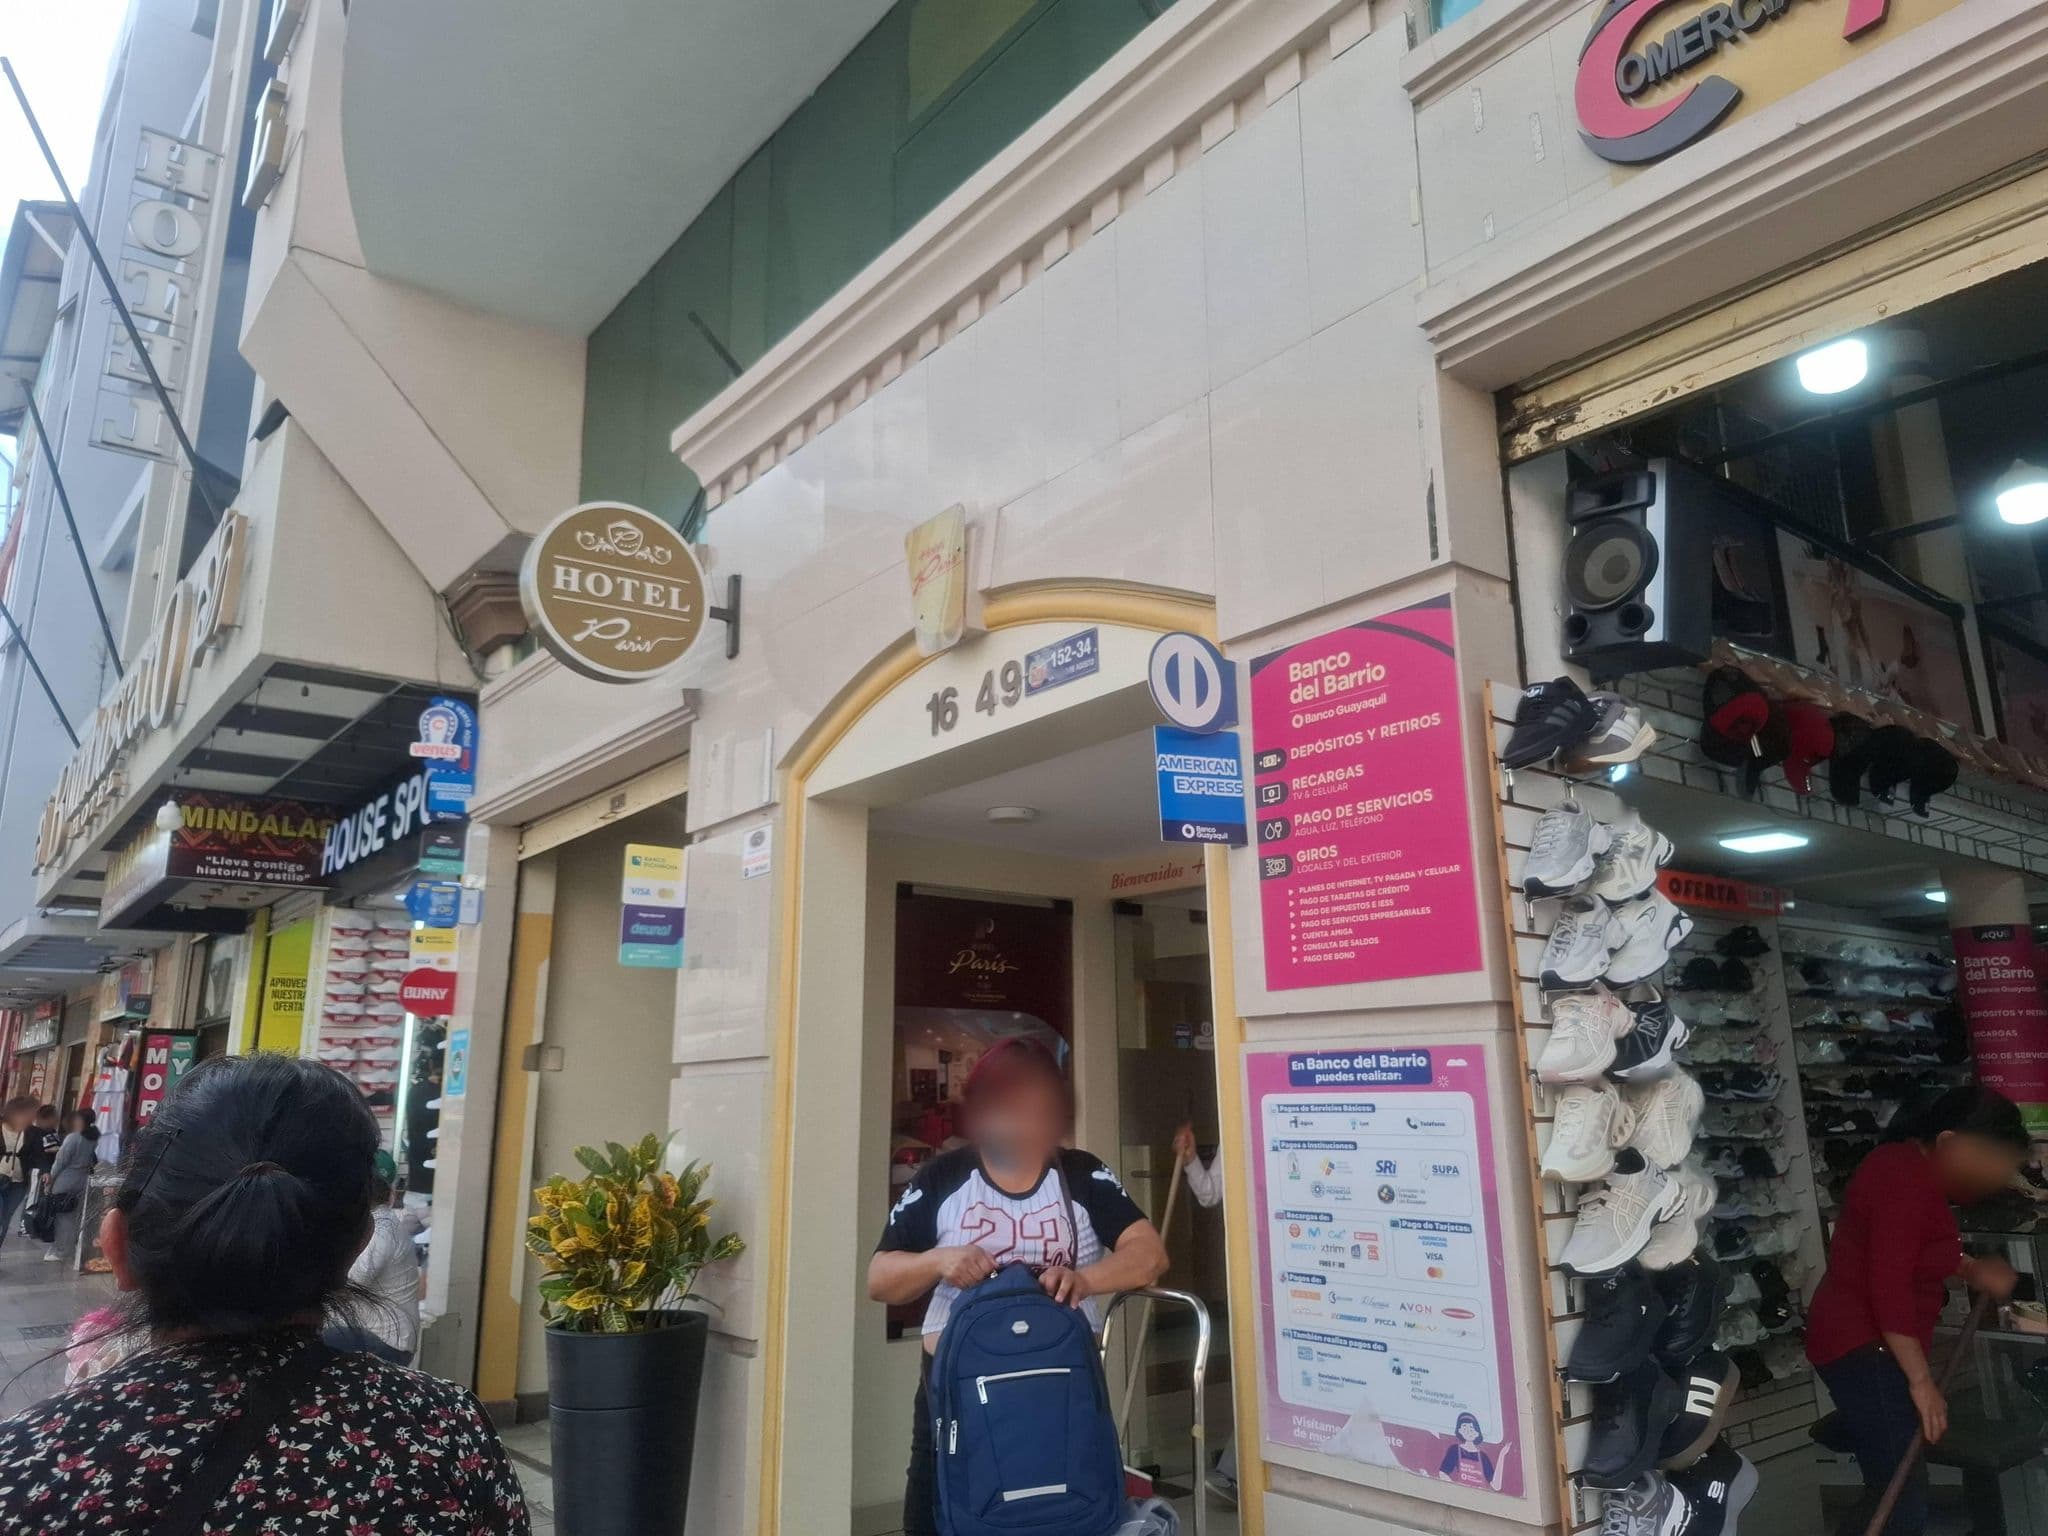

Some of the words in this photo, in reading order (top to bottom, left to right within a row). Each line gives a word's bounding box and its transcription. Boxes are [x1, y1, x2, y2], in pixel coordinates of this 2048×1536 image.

[553, 564, 691, 613] HOTEL
[1051, 637, 1092, 668] 152-34
[1289, 651, 1350, 682] Banco
[1290, 682, 1319, 704] del
[1323, 662, 1386, 695] Barrio
[926, 686, 959, 737] 16
[976, 660, 1023, 717] 49
[1304, 707, 1334, 725] Banco
[1336, 692, 1387, 715] Guayaquil
[1290, 730, 1364, 760] DEPÓSITOS
[1367, 727, 1376, 741] Y
[1380, 712, 1441, 738] RETIROS
[413, 744, 458, 757] venus
[1158, 756, 1236, 775] AMERICAN
[1292, 764, 1365, 791] RECARGAS
[1177, 778, 1243, 795] EXPRESS
[1293, 791, 1303, 801] TV
[1304, 789, 1311, 798] &
[1312, 782, 1349, 798] CELULAR
[1294, 808, 1332, 826] PAGO
[1335, 801, 1353, 818] DE
[1356, 788, 1433, 815] SERVICIOS
[320, 796, 389, 877] HOUSE
[1196, 825, 1216, 833] Banco
[1196, 831, 1228, 841] Guayaquil
[1296, 845, 1338, 863] GIROS
[1297, 861, 1334, 874] LOCALES
[1335, 859, 1341, 868] Y
[1343, 856, 1359, 867] DEL
[1361, 849, 1402, 865] EXTERIOR
[196, 864, 250, 877] historia
[253, 861, 305, 873] contigo
[1111, 862, 1184, 890] Bienvenidos
[1299, 884, 1325, 894] PLANES
[1326, 882, 1335, 890] DE
[1375, 875, 1384, 883] TV
[1385, 871, 1416, 882] PAGADA
[1424, 864, 1460, 877] CELULAR
[631, 887, 651, 896] VISA
[1300, 897, 1318, 905] PAGO
[1319, 895, 1329, 903] DE
[1330, 890, 1365, 902] TARJETAS
[1366, 888, 1376, 897] DE
[1377, 884, 1410, 896] CRÉDITO
[1668, 877, 1738, 904] OFERTA
[1301, 907, 1319, 917] PAGO
[1320, 905, 1329, 914] DE
[1331, 901, 1370, 913] IMPUESTOS
[1301, 919, 1320, 929] PAGO
[1321, 918, 1331, 926] DE
[1332, 913, 1369, 924] SERVICIOS
[1370, 906, 1431, 920] EMPRESARIALES
[1303, 930, 1329, 940] CUENTA
[1330, 928, 1353, 937] AMIGA
[1303, 941, 1338, 951] CONSULTA
[1339, 939, 1349, 948] DE
[1350, 936, 1379, 946] SALDOS
[1303, 954, 1322, 963] PAGO
[1323, 952, 1333, 961] DE
[1334, 951, 1355, 961] BONO
[1963, 955, 2010, 968] Banco
[1966, 967, 1986, 981] del
[1990, 966, 2034, 980] Barrio
[403, 986, 448, 1001] BUNNY
[1291, 1060, 1305, 1071] En
[1307, 1057, 1350, 1071] Banco
[1353, 1055, 1376, 1068] del
[1380, 1053, 1427, 1067] Barrio
[2000, 1052, 2012, 1061] DE
[172, 1058, 190, 1076] Y
[1315, 1071, 1354, 1084] puedes
[1357, 1070, 1402, 1082] realizar:
[1432, 1165, 1460, 1176] SUPA
[1402, 1220, 1422, 1230] Pago
[1425, 1252, 1443, 1261] VISA
[1400, 1303, 1432, 1314] AVON
[1294, 1427, 1307, 1439] de
